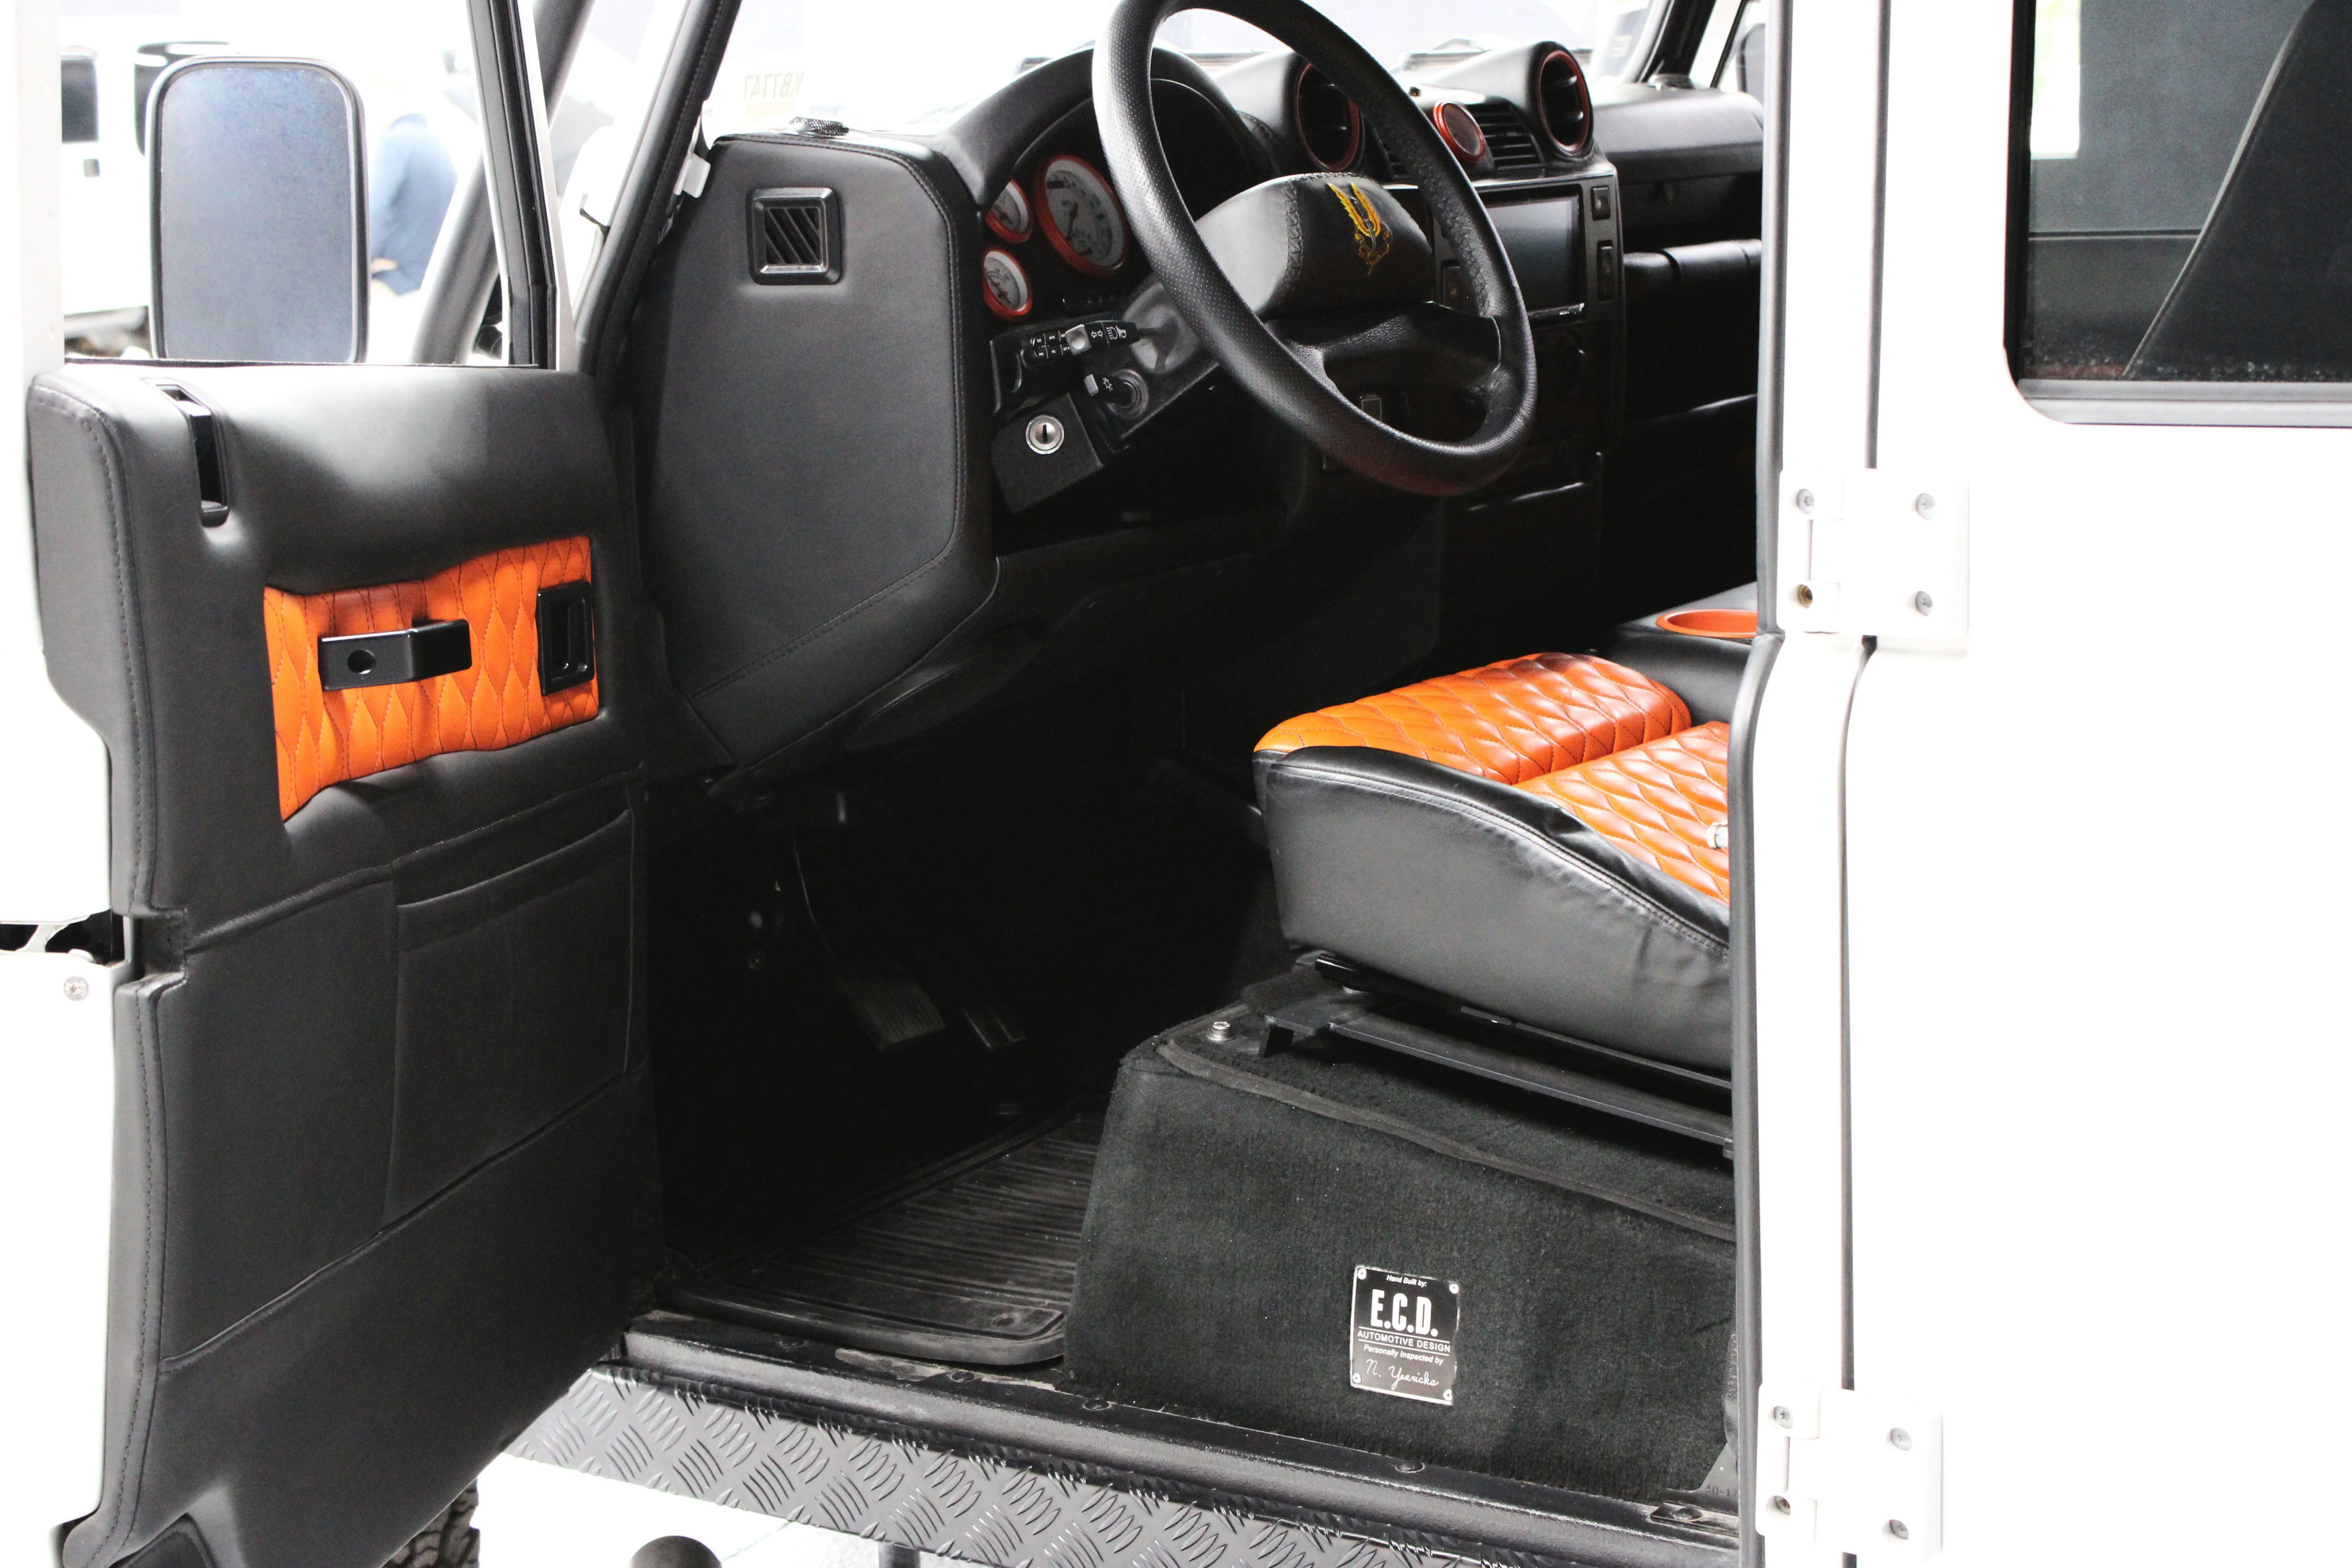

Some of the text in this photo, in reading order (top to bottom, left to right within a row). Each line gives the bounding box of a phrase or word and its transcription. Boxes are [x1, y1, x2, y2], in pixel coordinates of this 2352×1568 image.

[1386, 1274, 1428, 1288] Hand Built by:
[1370, 1289, 1438, 1337] E.C.D.
[1357, 1330, 1450, 1353] AUTOMOTIVE DESIGN
[1363, 1344, 1443, 1366] Personally Inspected by
